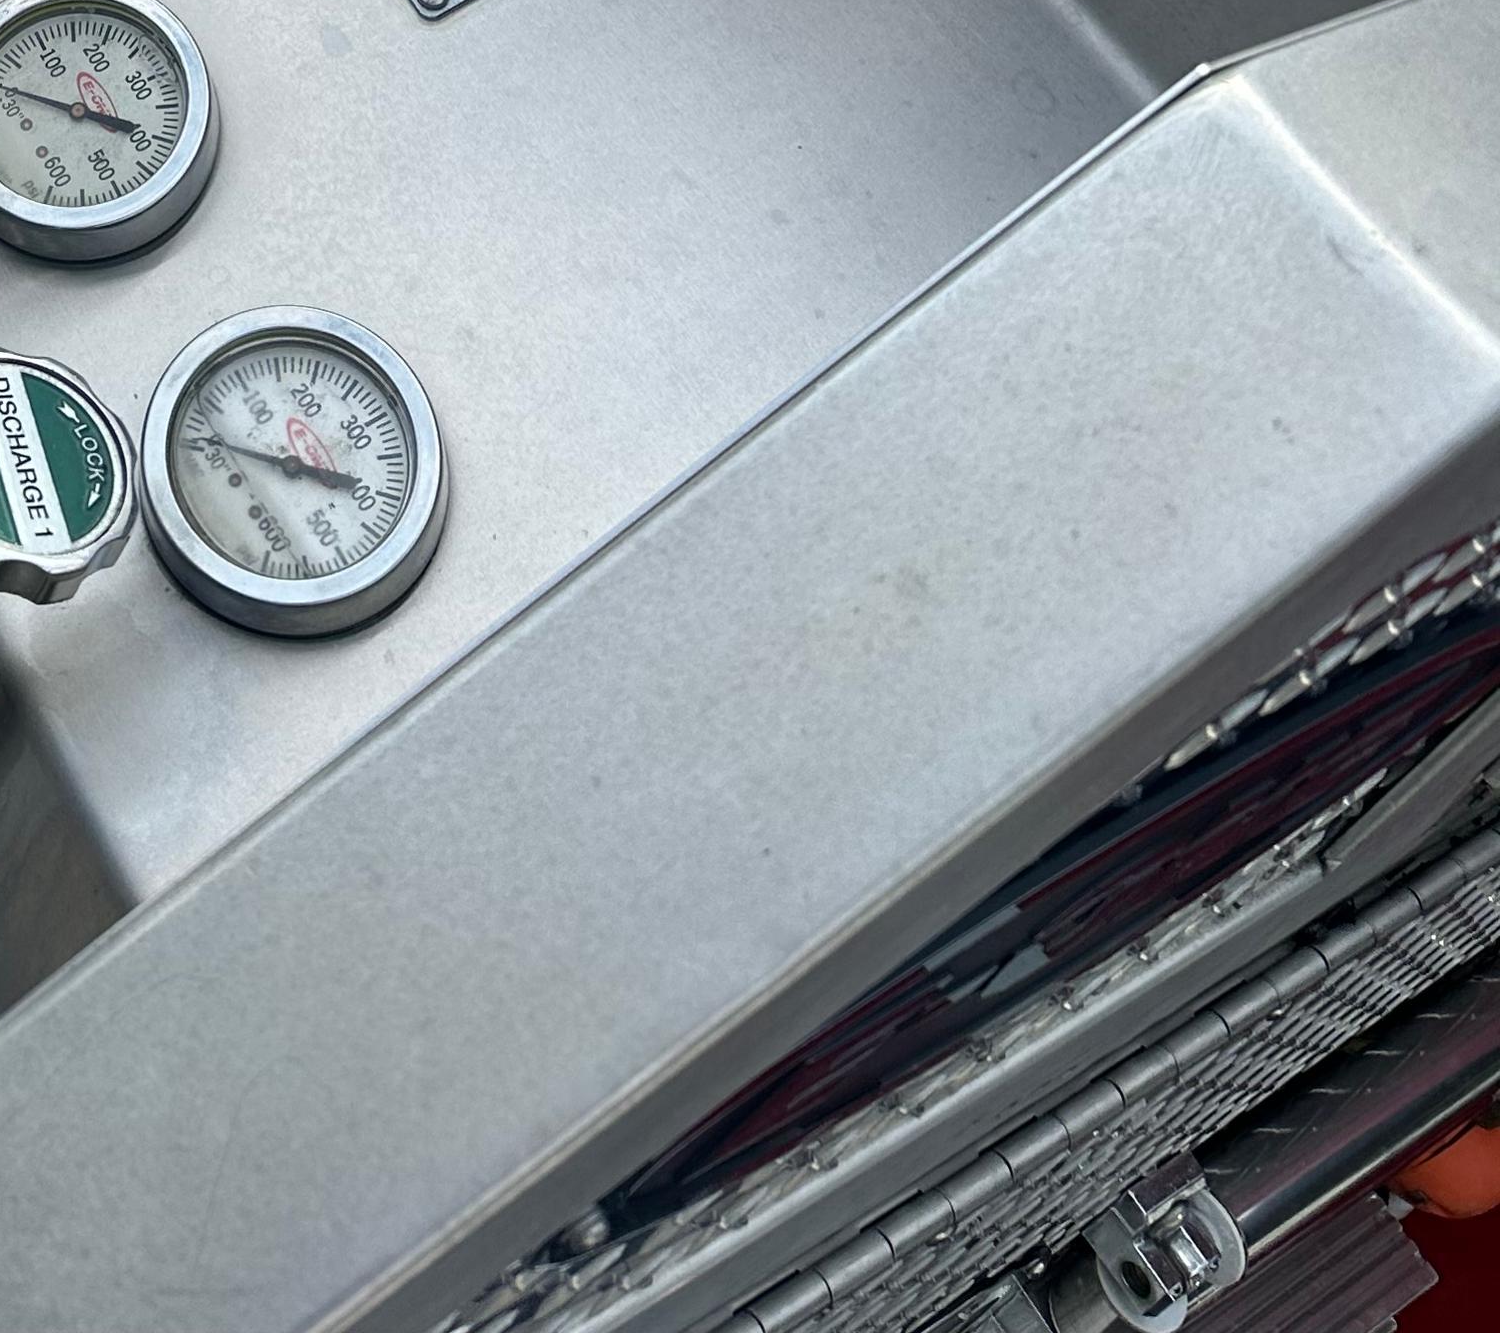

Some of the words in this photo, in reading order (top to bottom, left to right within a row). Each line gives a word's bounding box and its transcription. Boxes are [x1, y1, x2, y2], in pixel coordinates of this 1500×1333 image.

[40, 49, 66, 78] 100
[82, 43, 110, 73] 200
[125, 70, 152, 101] 300
[130, 124, 152, 153] 00
[44, 156, 72, 188] 600
[88, 149, 115, 182] 500
[242, 390, 273, 425] 100
[290, 384, 322, 418] 200
[340, 414, 372, 450] 300
[74, 424, 105, 482] LOCK
[350, 478, 376, 511] 00
[35, 527, 54, 537] 1
[259, 514, 291, 552] 600
[306, 509, 339, 547] 500
